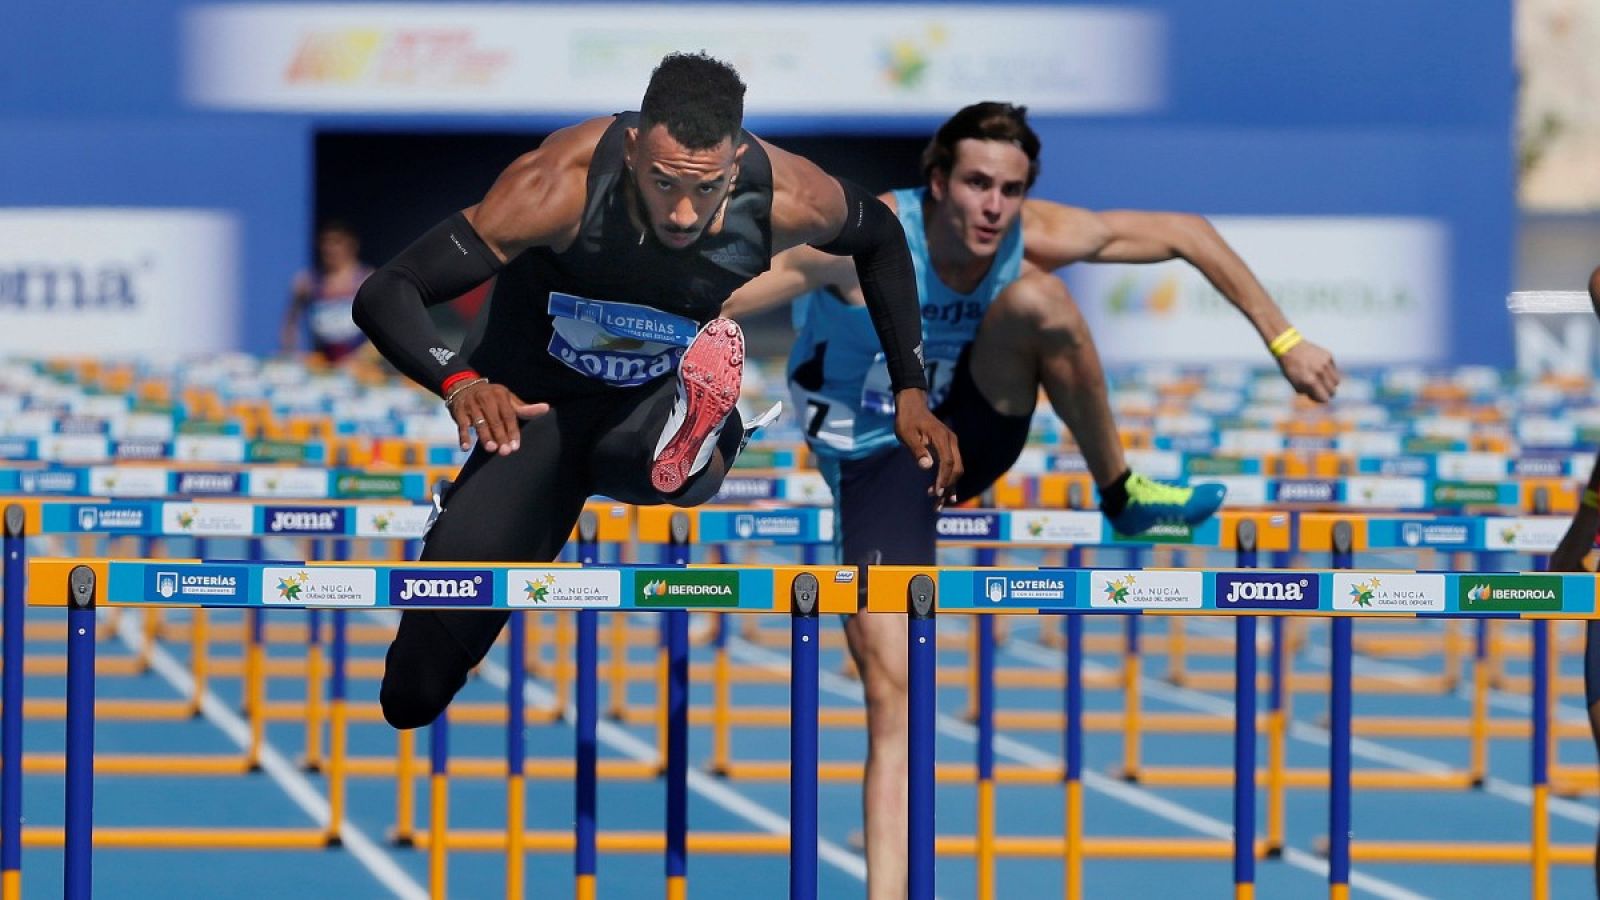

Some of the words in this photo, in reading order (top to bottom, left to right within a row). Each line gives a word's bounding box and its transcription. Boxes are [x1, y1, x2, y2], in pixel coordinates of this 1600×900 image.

[922, 301, 983, 323] erja
[182, 575, 236, 586] LOTERÍAS
[1010, 579, 1064, 589] LOTERÍAS
[668, 585, 732, 595] IBERDROLA
[1492, 589, 1555, 599] IBERDROLA
